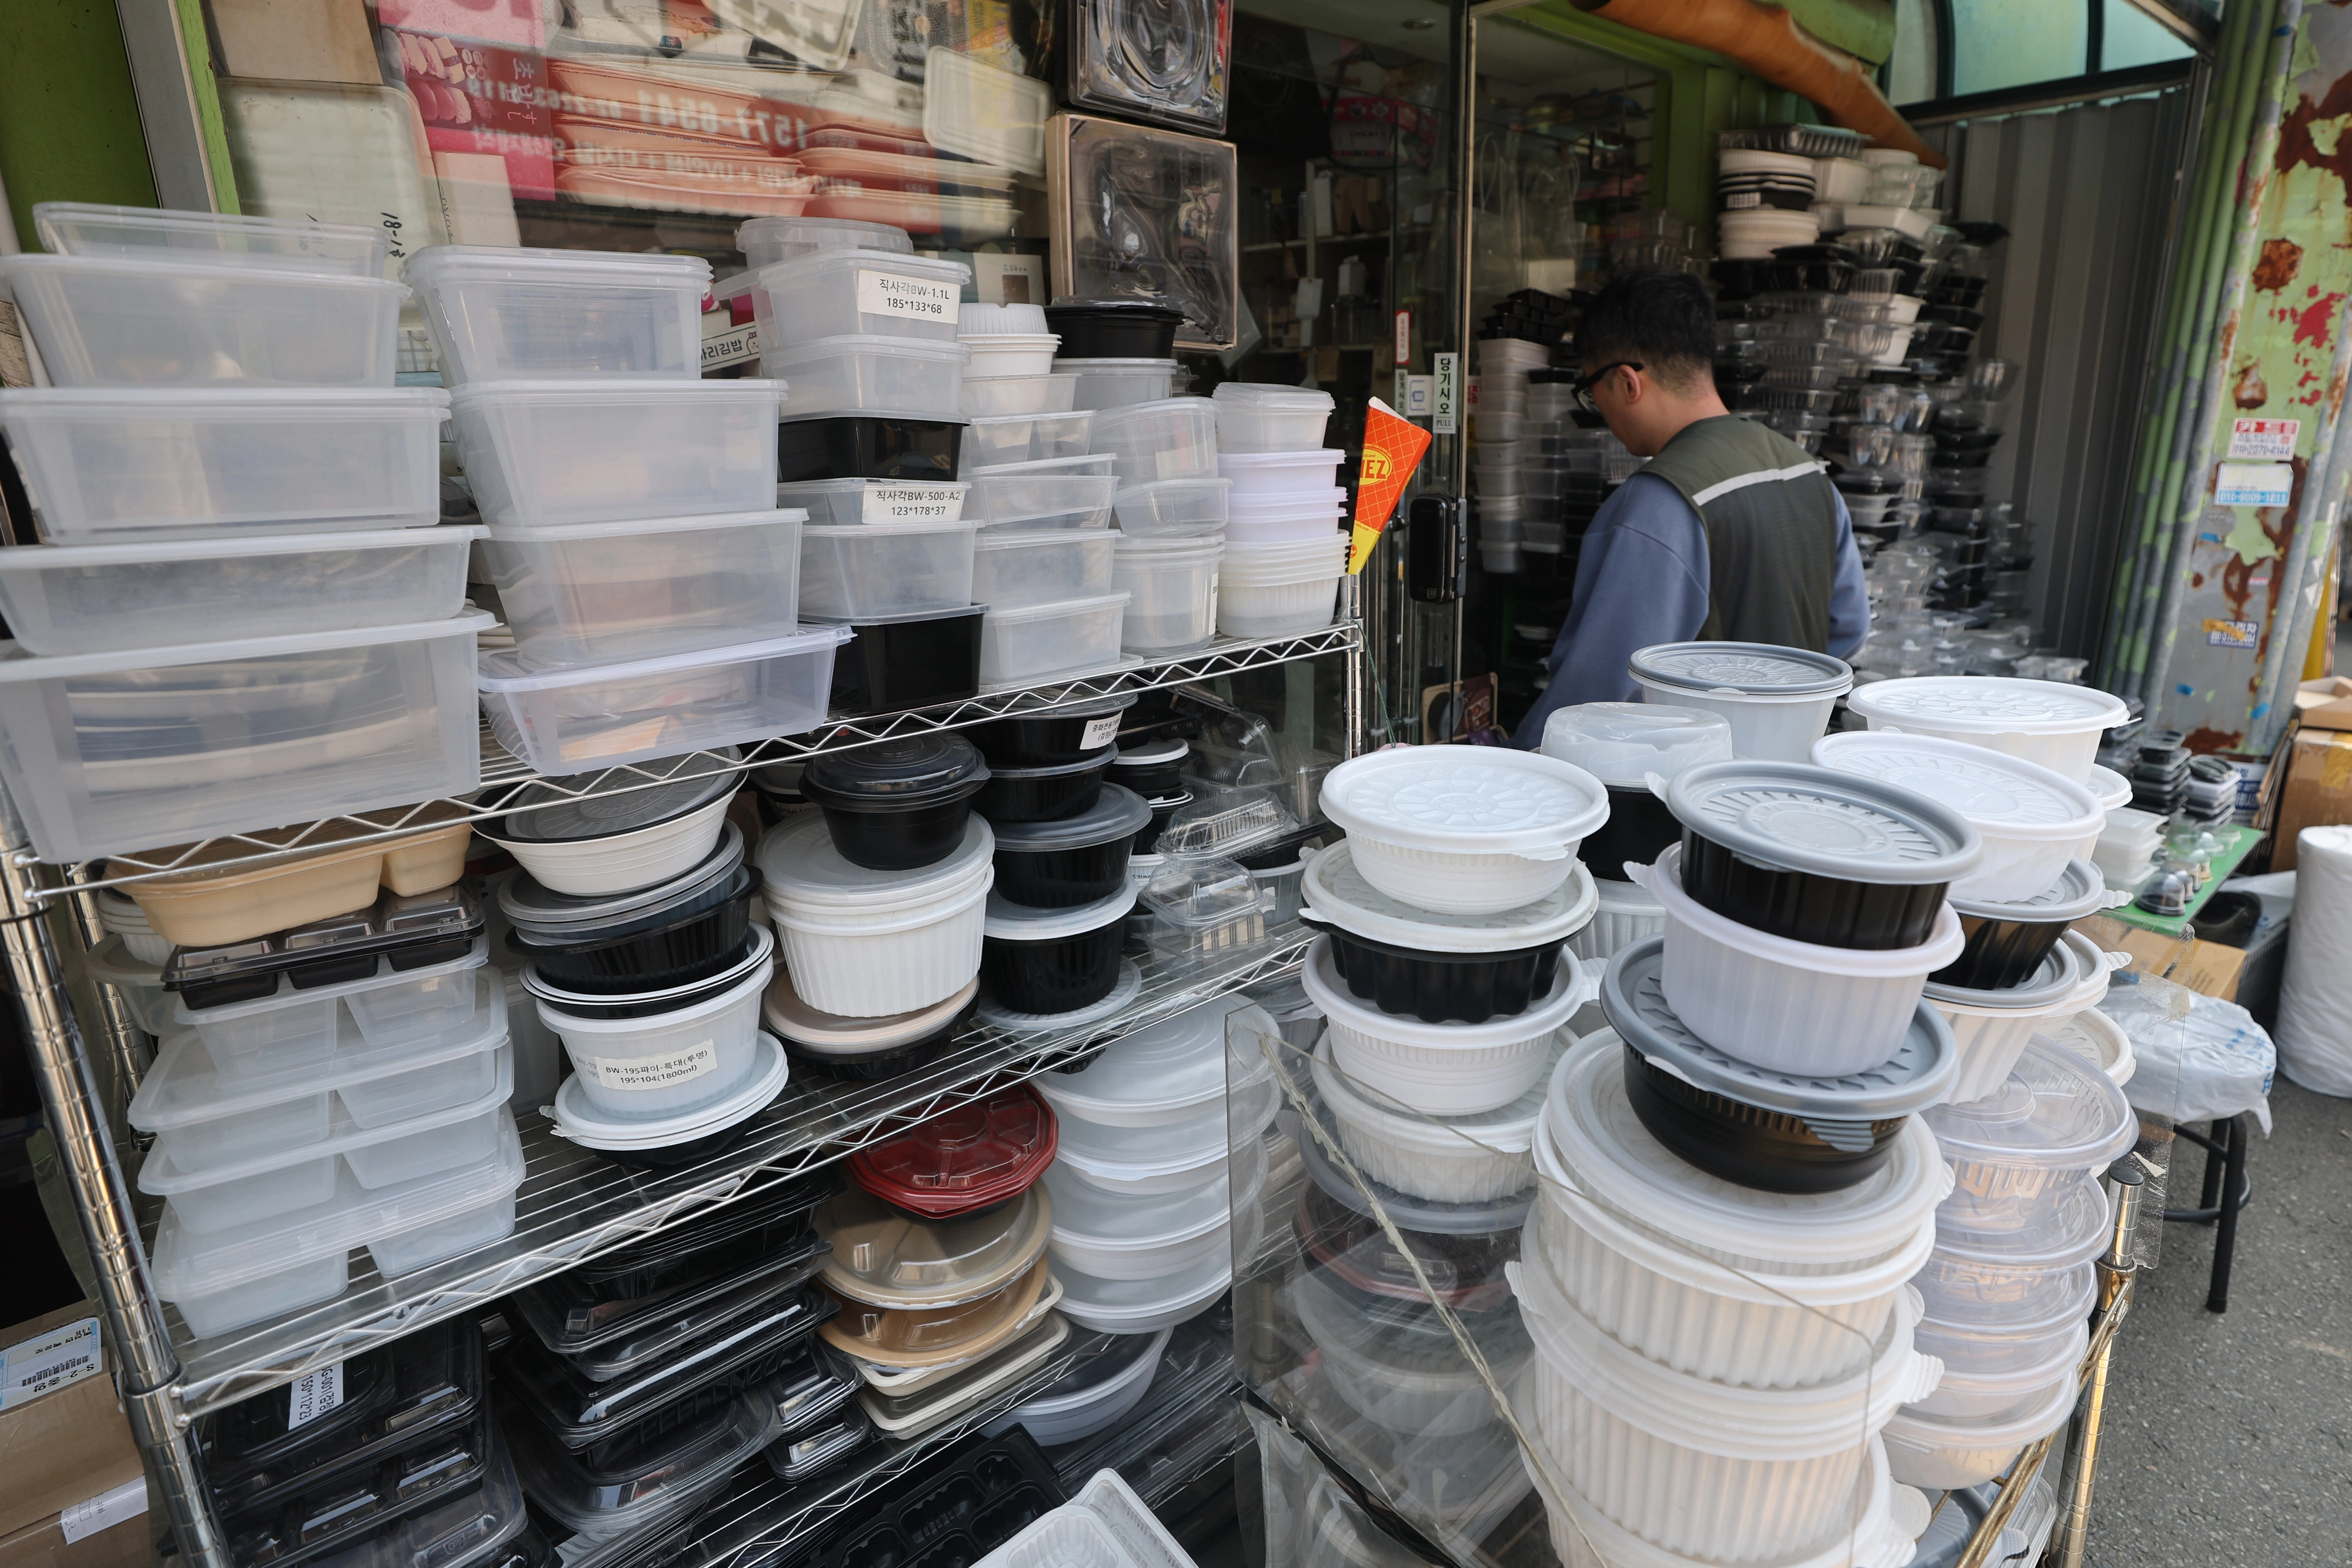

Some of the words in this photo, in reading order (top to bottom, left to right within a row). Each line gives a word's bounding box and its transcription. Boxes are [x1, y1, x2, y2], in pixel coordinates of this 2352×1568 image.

[506, 58, 537, 109] 초밥
[507, 111, 537, 125] すし
[879, 279, 950, 300] 직사각BW-1.1L
[1438, 357, 1451, 414] 당기시오
[1436, 419, 1452, 427] PULL
[876, 490, 961, 503] 직사각BW-500-A2
[605, 1049, 708, 1075] BW-195파이-특대(투명)
[33, 1363, 94, 1393] S-2-중앙
